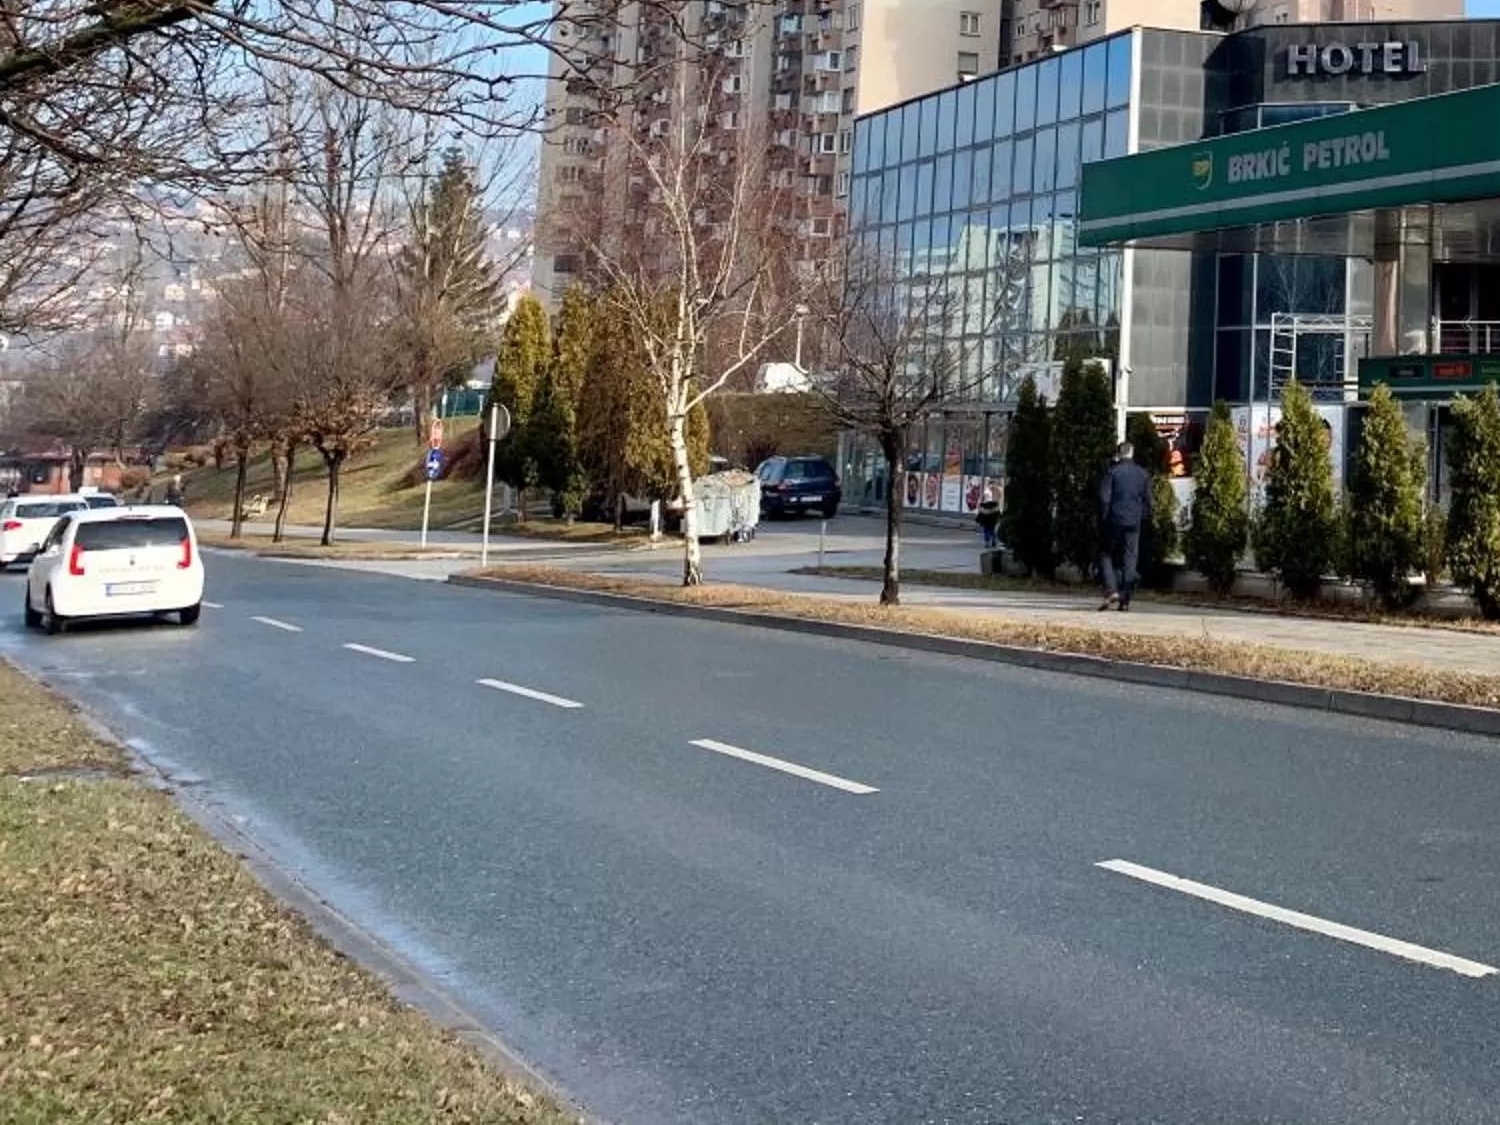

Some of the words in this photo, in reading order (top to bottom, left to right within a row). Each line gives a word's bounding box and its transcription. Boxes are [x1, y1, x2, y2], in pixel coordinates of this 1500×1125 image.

[1287, 40, 1428, 75] HOTEL
[1227, 140, 1292, 184] BRKIĆ
[1303, 130, 1391, 172] PETROL
